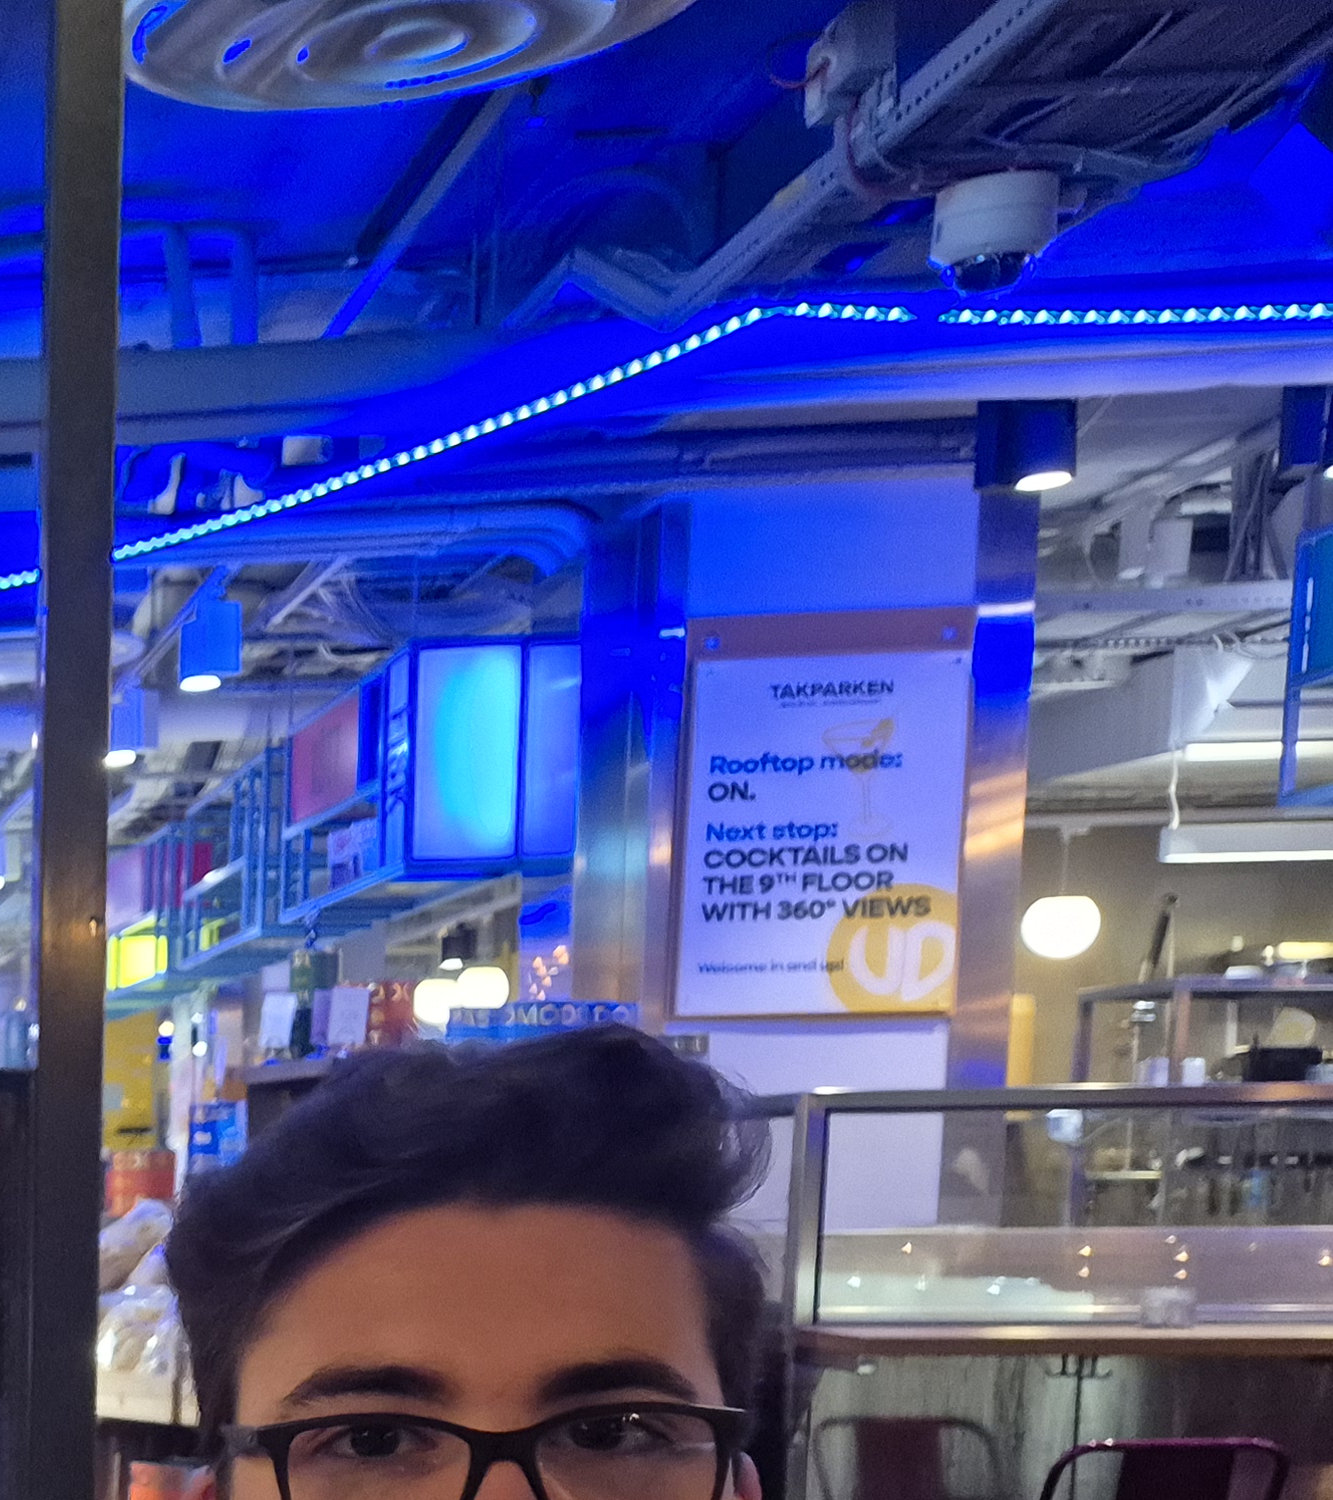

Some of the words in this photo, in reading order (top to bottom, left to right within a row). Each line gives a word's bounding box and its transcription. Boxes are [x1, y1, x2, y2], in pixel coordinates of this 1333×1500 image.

[769, 679, 895, 699] TAKPARKEN
[709, 751, 815, 776] Rooftop
[707, 780, 757, 802] ON.
[705, 821, 767, 843] Next
[772, 821, 839, 845] stop:
[703, 843, 861, 870] COCKTAILS
[865, 842, 909, 864] ON
[702, 874, 754, 896] THE
[802, 870, 895, 893] FLOOR
[700, 900, 772, 922] WITH
[842, 896, 933, 919] VIEWS
